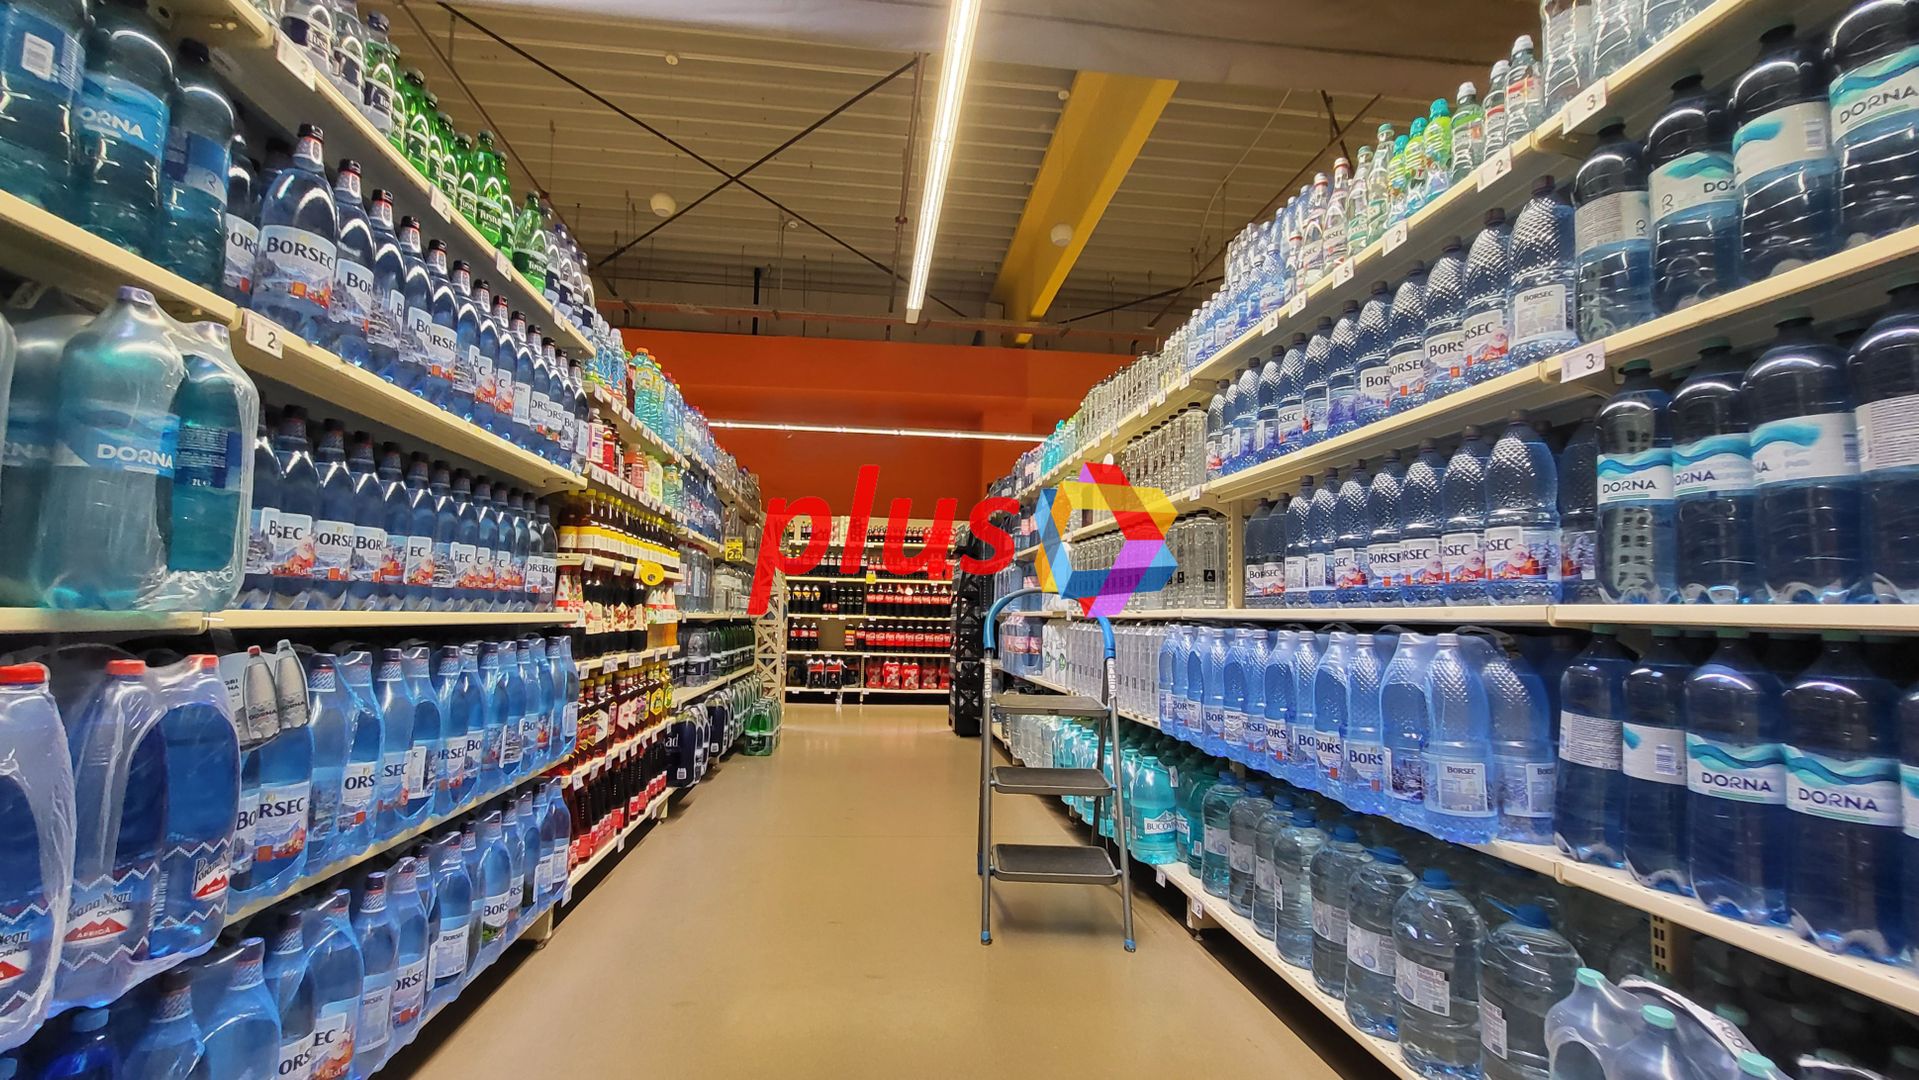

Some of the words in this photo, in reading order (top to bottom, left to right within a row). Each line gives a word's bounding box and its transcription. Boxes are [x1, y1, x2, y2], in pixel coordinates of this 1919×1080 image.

[1587, 94, 1596, 110] 3
[1839, 84, 1919, 126] DORNA
[80, 105, 145, 141] ORNA
[1495, 159, 1503, 175] 2
[1395, 229, 1402, 243] 2
[266, 236, 334, 271] BORSEC
[1343, 266, 1350, 278] 5
[1523, 290, 1554, 302] BORSEC
[267, 331, 276, 349] 2
[1585, 353, 1595, 370] 3
[97, 443, 174, 470] DORNA
[1602, 479, 1657, 494] DORNA
[1447, 766, 1476, 775] BORSEC
[1702, 772, 1772, 793] DORNA
[258, 797, 305, 818] RSEC
[1798, 787, 1879, 812] DORNA
